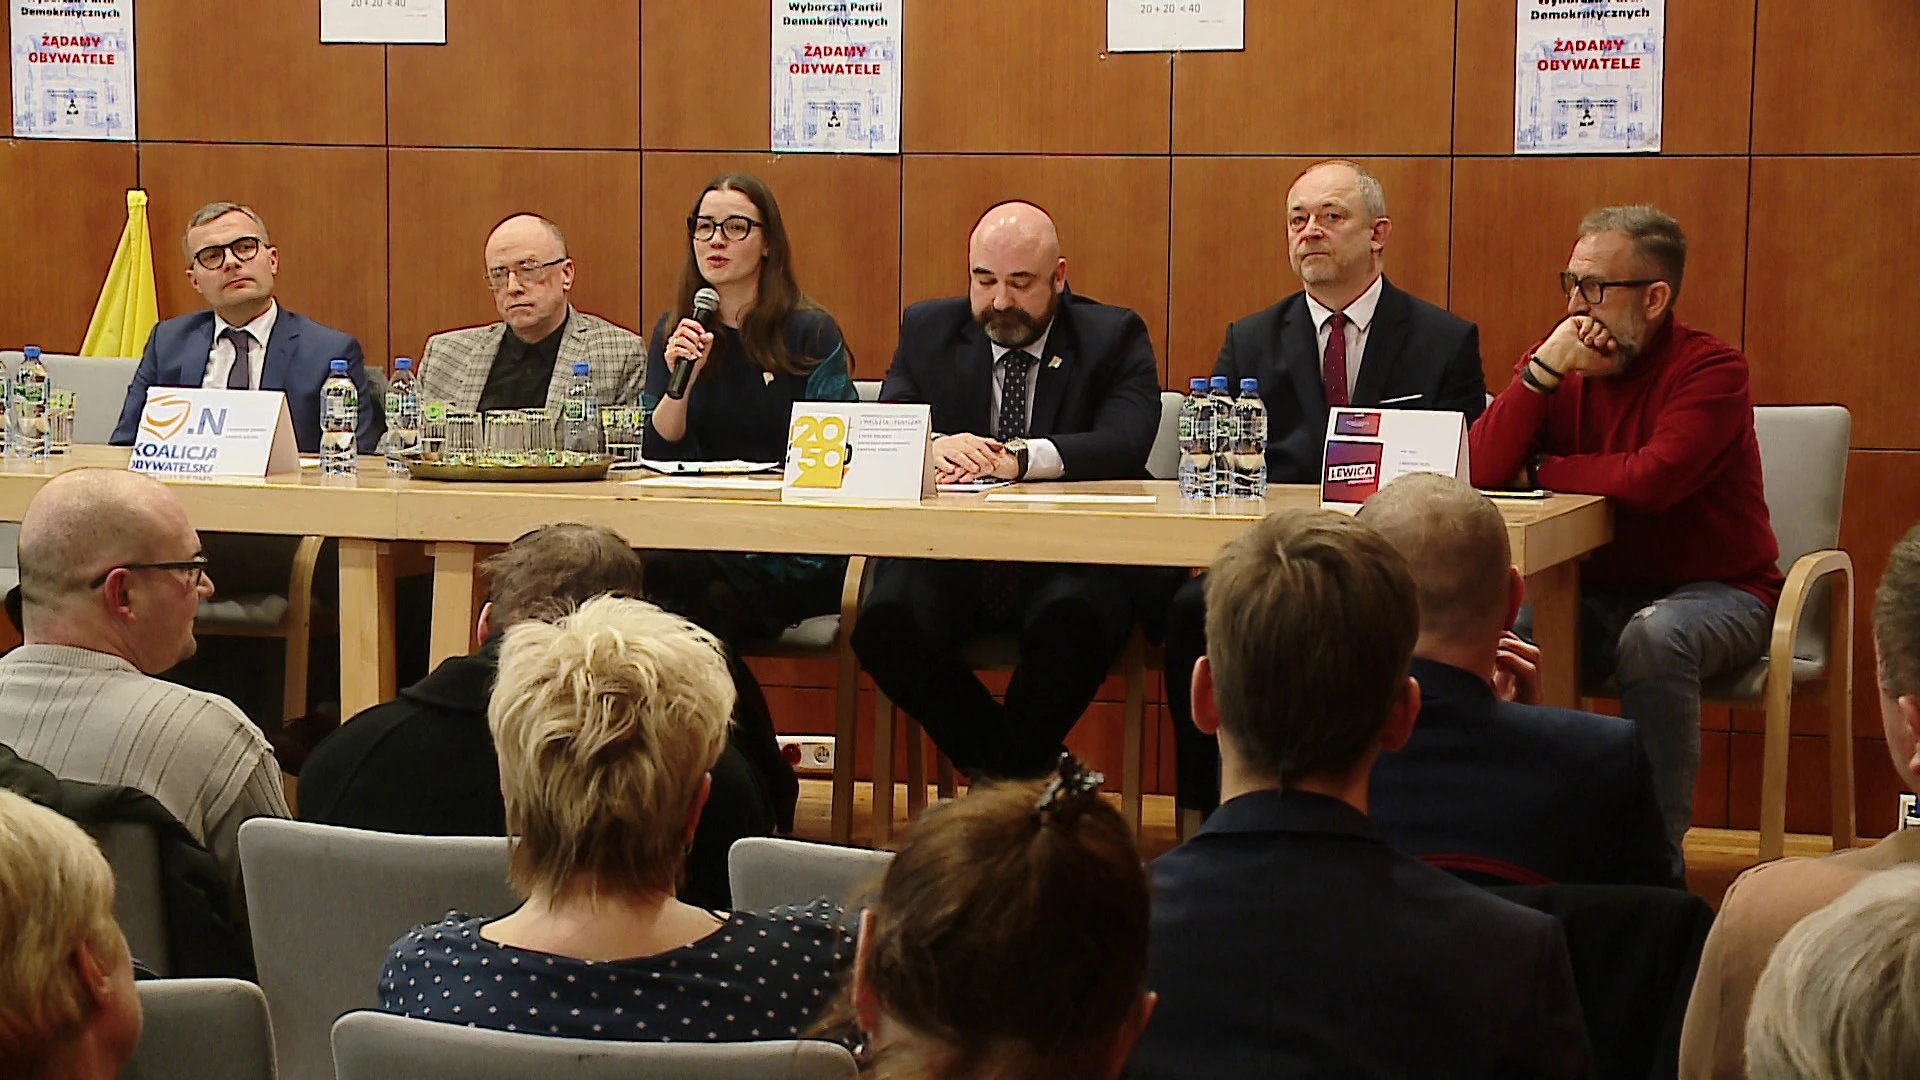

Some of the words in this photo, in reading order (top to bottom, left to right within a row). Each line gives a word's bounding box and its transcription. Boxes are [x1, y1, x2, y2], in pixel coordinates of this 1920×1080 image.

[21, 6, 120, 19] Demokratycznych
[787, 2, 847, 13] Wyborcza
[850, 2, 883, 12] Partii
[1140, 4, 1152, 14] 20
[1163, 4, 1175, 14] 20
[1188, 4, 1201, 14] 40
[1530, 8, 1650, 20] Demokratycznych
[783, 16, 888, 28] Demokratycznych
[42, 32, 101, 49] ŻĄDAMY
[1553, 37, 1624, 54] ŻĄDAMY
[804, 42, 867, 59] ŻĄDAMY
[28, 52, 115, 65] OBYWATELE
[1537, 58, 1641, 71] OBYWATELE
[789, 63, 881, 75] OBYWATELE
[1330, 465, 1373, 480] LEWICA
